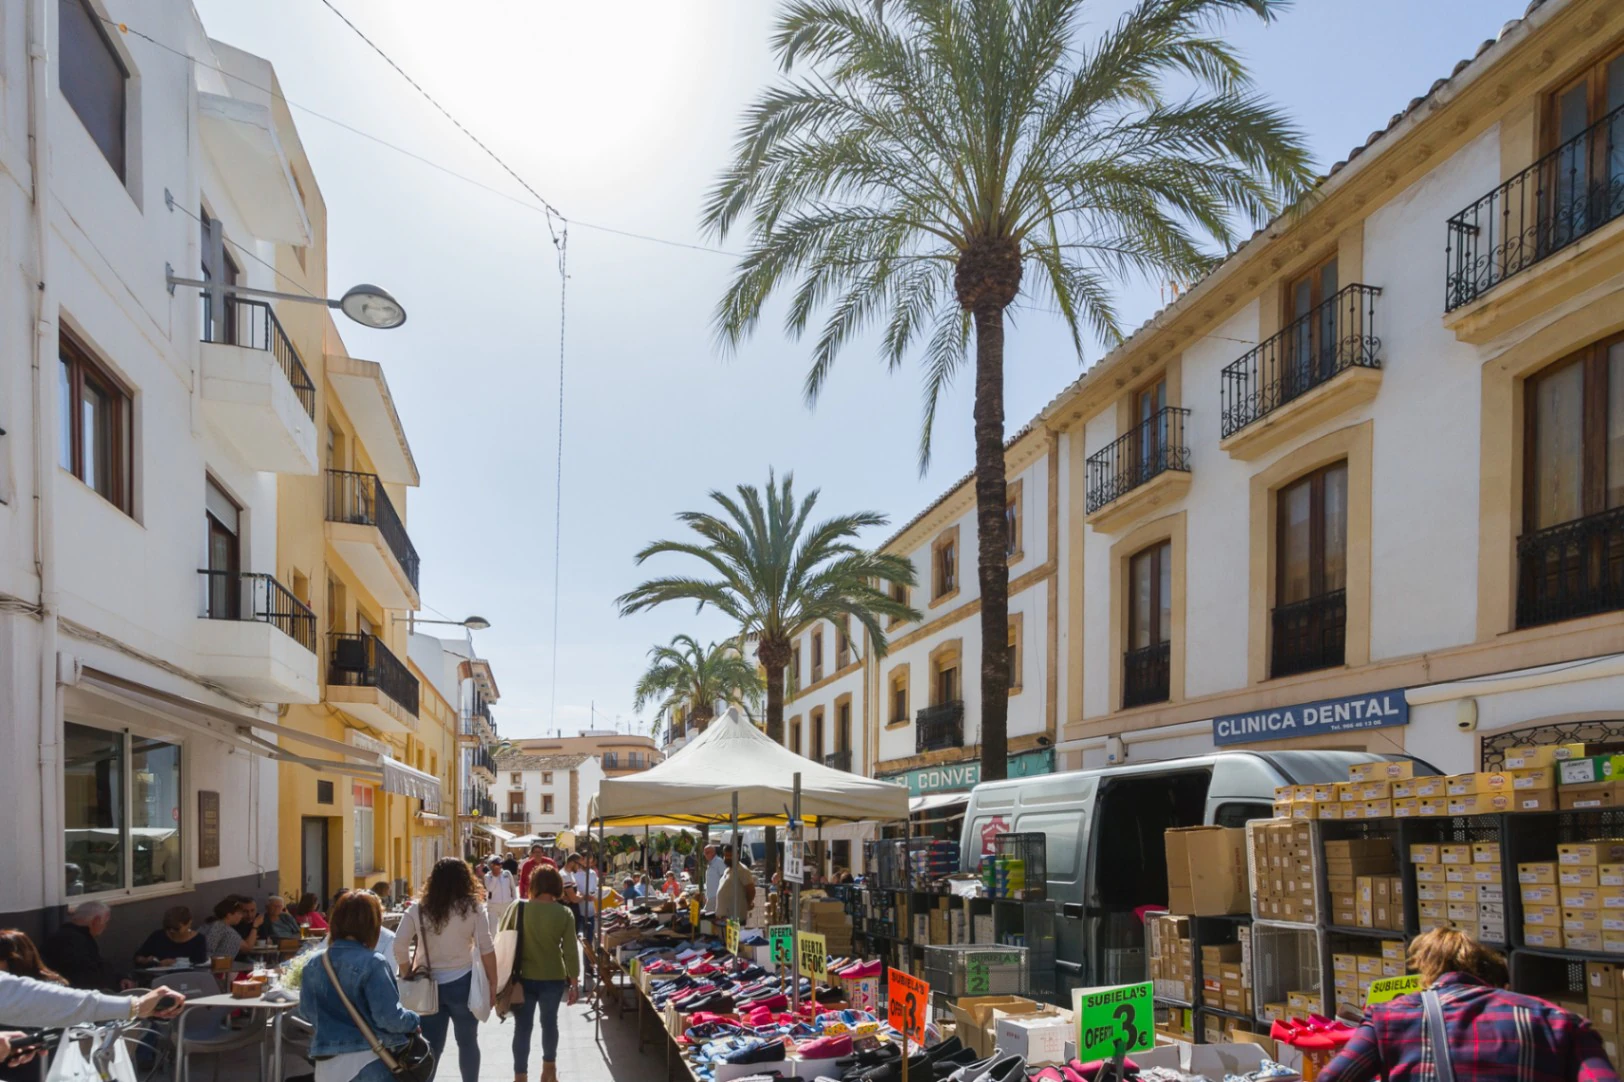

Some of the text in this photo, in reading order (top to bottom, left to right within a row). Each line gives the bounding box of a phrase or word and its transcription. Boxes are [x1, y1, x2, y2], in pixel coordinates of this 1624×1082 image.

[1218, 696, 1399, 737] CLINICA DENTAL
[918, 766, 980, 789] CONVE
[800, 939, 823, 955] OFERTA
[1087, 986, 1147, 1008] SUBIELA'S
[1085, 1026, 1114, 1050] OFERTA
